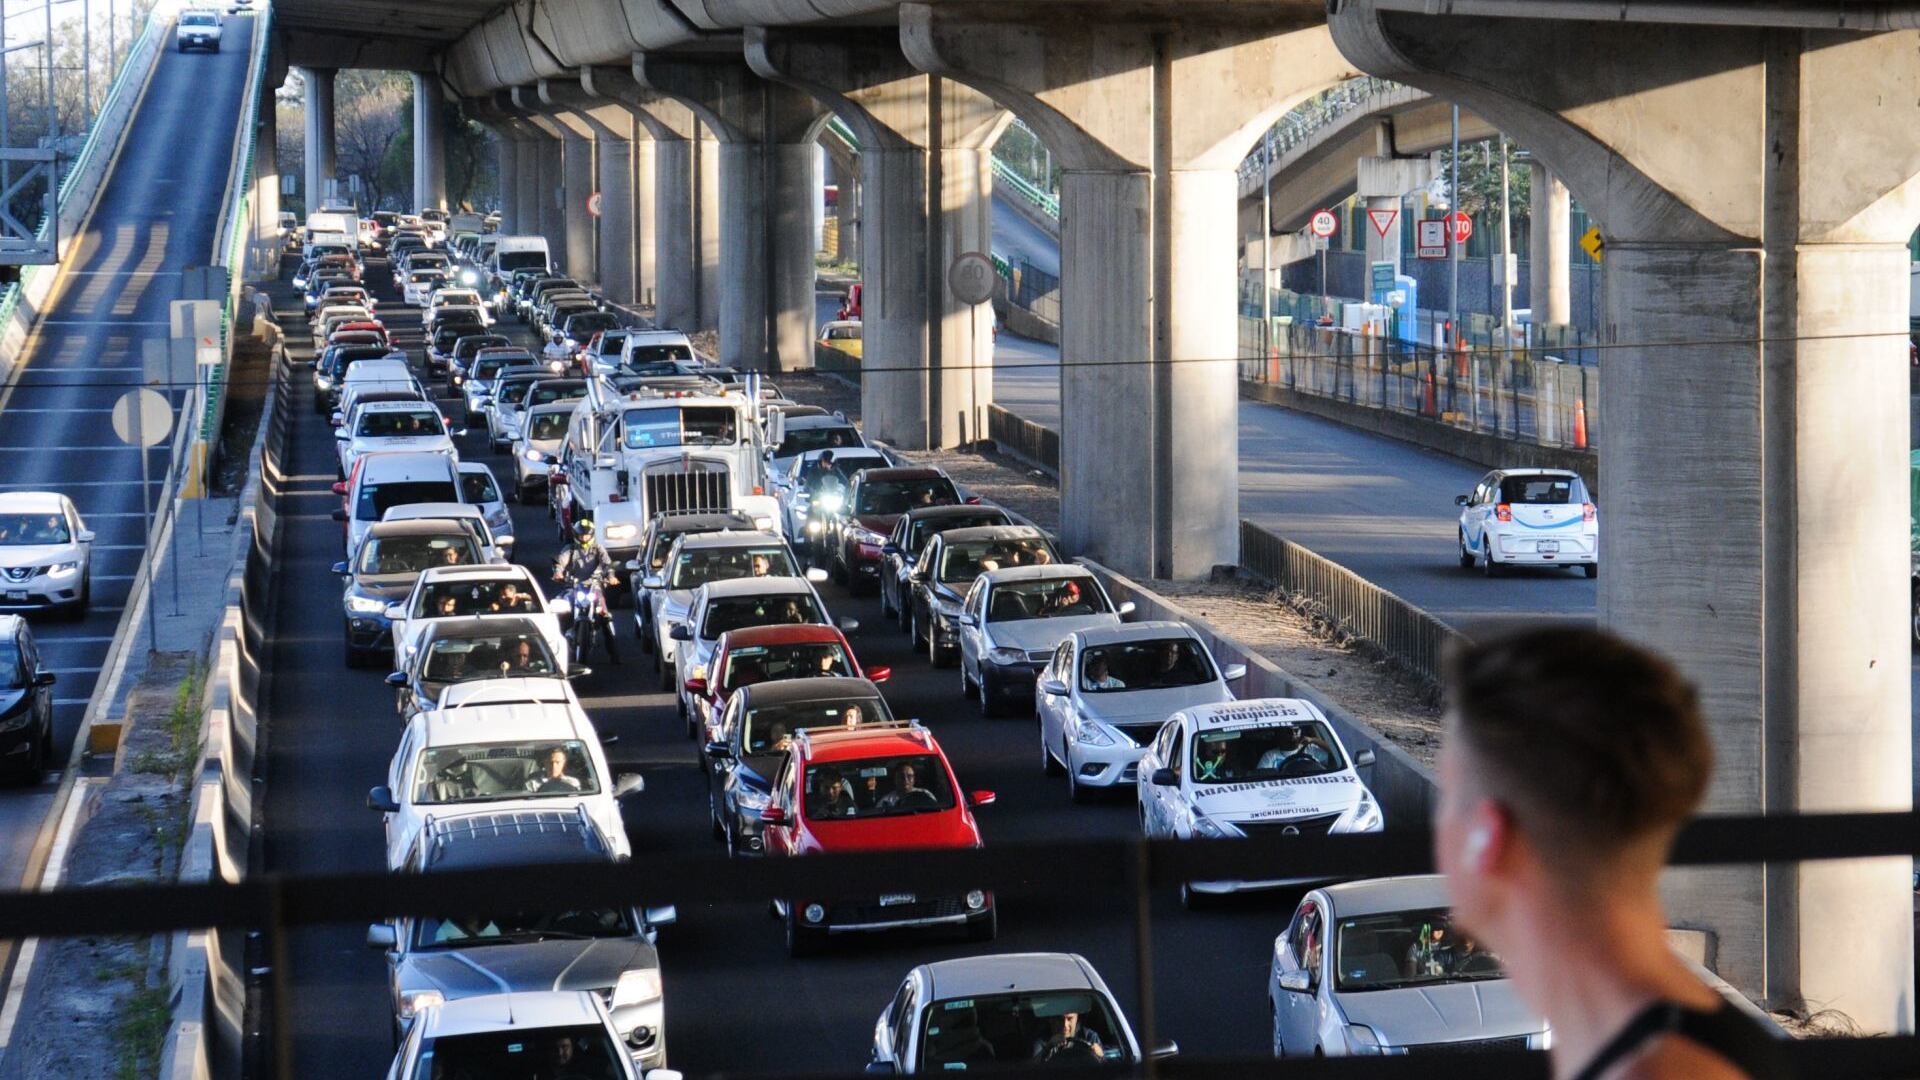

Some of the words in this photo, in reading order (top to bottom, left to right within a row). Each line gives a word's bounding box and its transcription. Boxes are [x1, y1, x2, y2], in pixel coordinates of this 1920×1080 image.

[1317, 216, 1330, 225] 40
[1214, 704, 1285, 714] PRIVADA
[1208, 708, 1298, 723] SEGURIDAD
